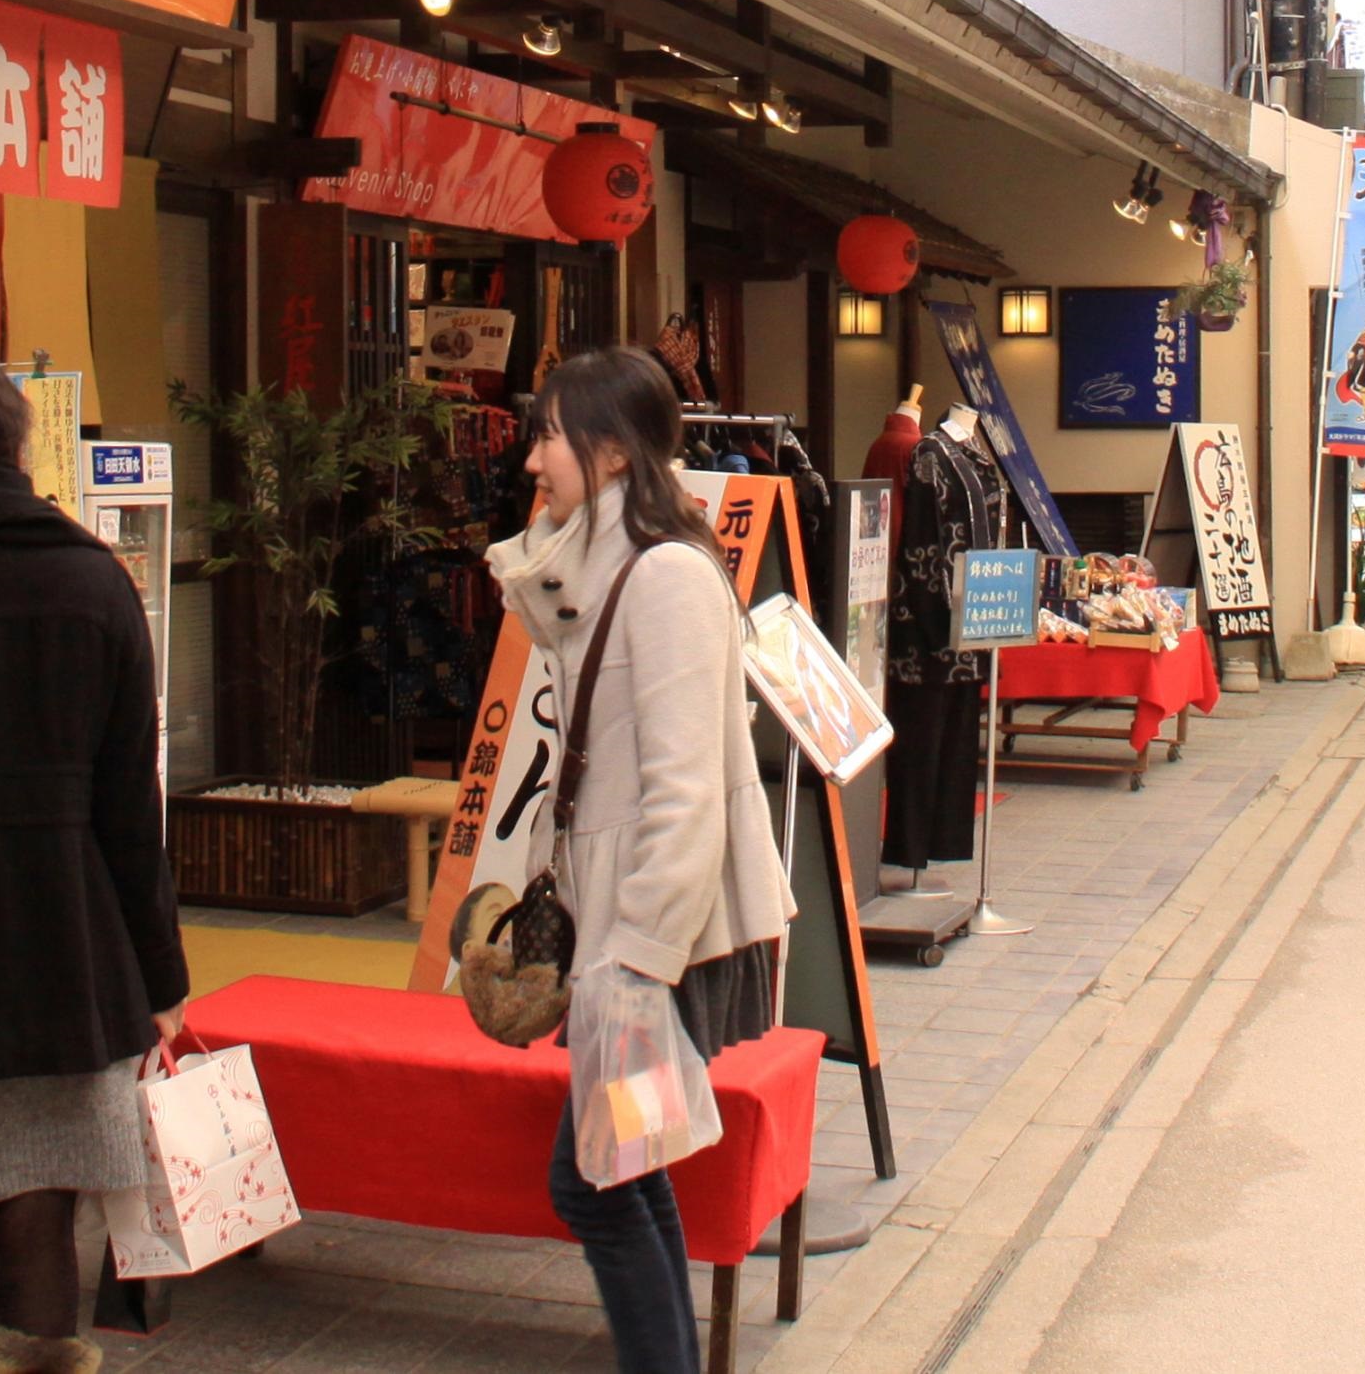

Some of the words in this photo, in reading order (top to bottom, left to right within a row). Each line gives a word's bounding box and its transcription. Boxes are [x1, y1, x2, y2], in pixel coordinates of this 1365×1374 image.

[394, 171, 434, 208] Shop
[1153, 298, 1177, 414] まめたぬき
[1215, 430, 1255, 605] 広島の地酒
[1218, 610, 1271, 636] まめたぬき
